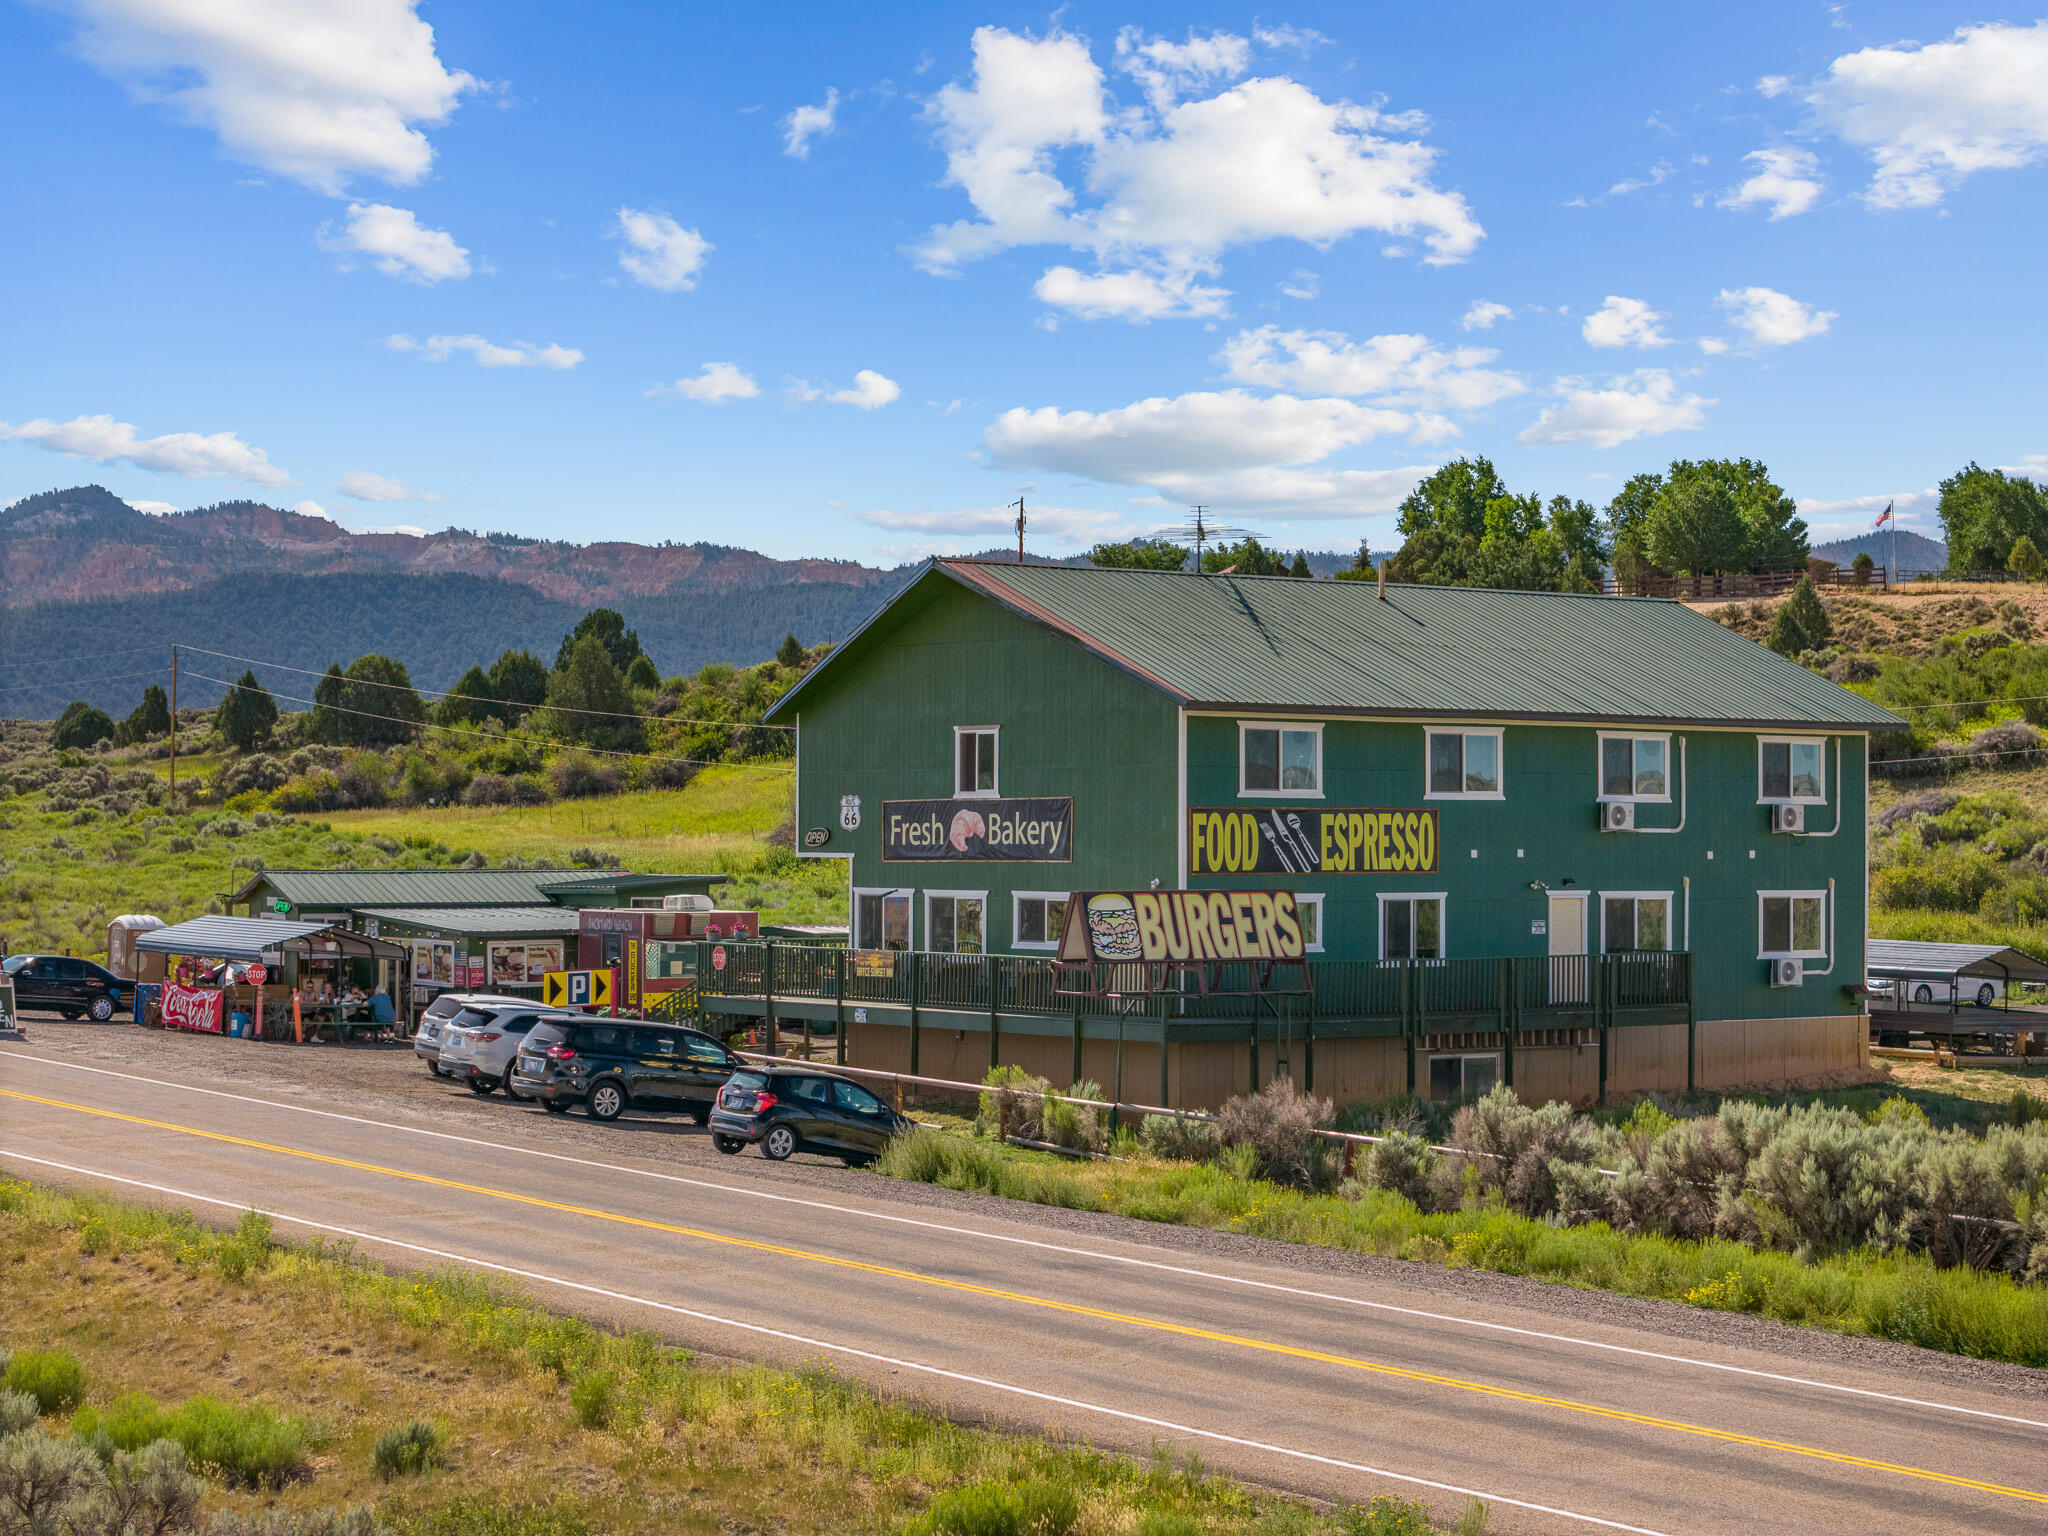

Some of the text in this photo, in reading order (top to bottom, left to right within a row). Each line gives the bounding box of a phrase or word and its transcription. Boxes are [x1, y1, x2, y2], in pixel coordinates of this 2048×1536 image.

[844, 812, 857, 826] 66
[806, 831, 826, 843] OPEN
[890, 811, 1063, 854] Fresh Bakery
[1192, 812, 1434, 872] FOOD ESPRESSO
[1133, 892, 1305, 960] BURGERS
[713, 953, 726, 962] STOP
[248, 969, 265, 979] STOP
[856, 967, 894, 978] BRYCE SUNSET INN
[572, 975, 586, 1003] P
